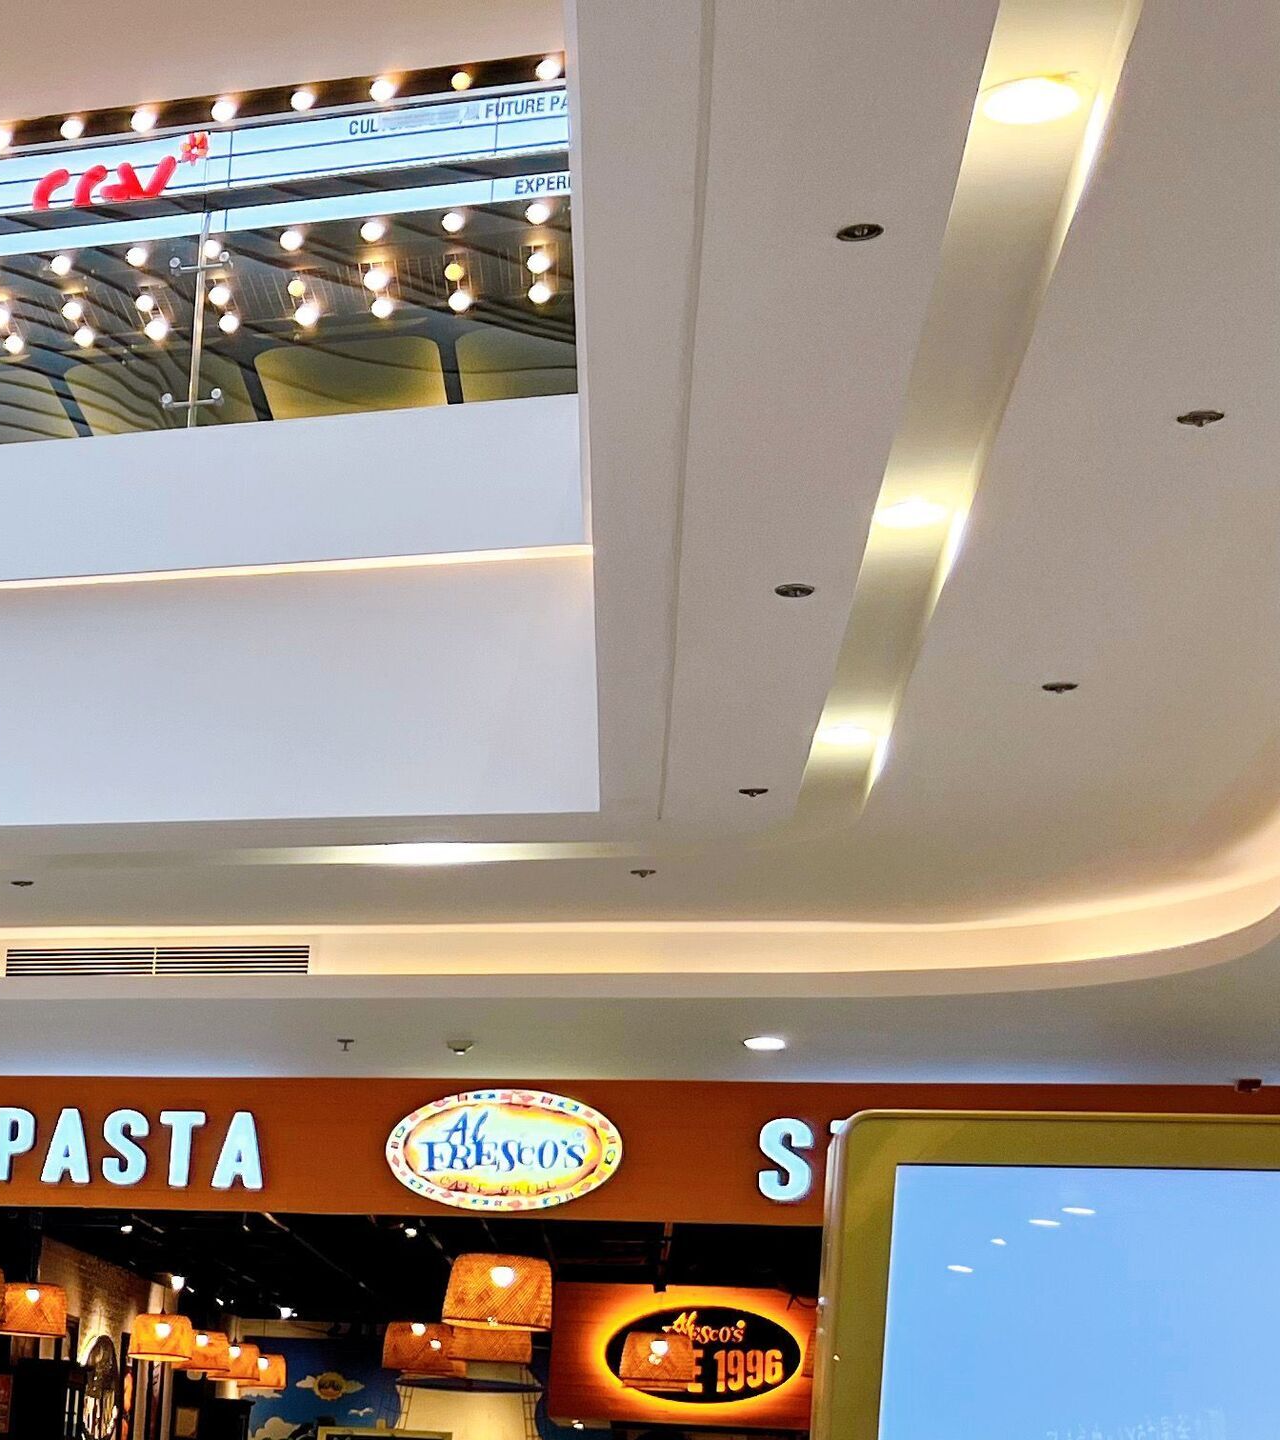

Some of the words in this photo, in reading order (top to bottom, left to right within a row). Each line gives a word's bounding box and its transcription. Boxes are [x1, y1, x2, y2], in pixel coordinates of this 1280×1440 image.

[485, 97, 545, 118] FUTURE
[419, 1138, 586, 1173] FRESCO'S
[713, 1349, 784, 1393] 1996
